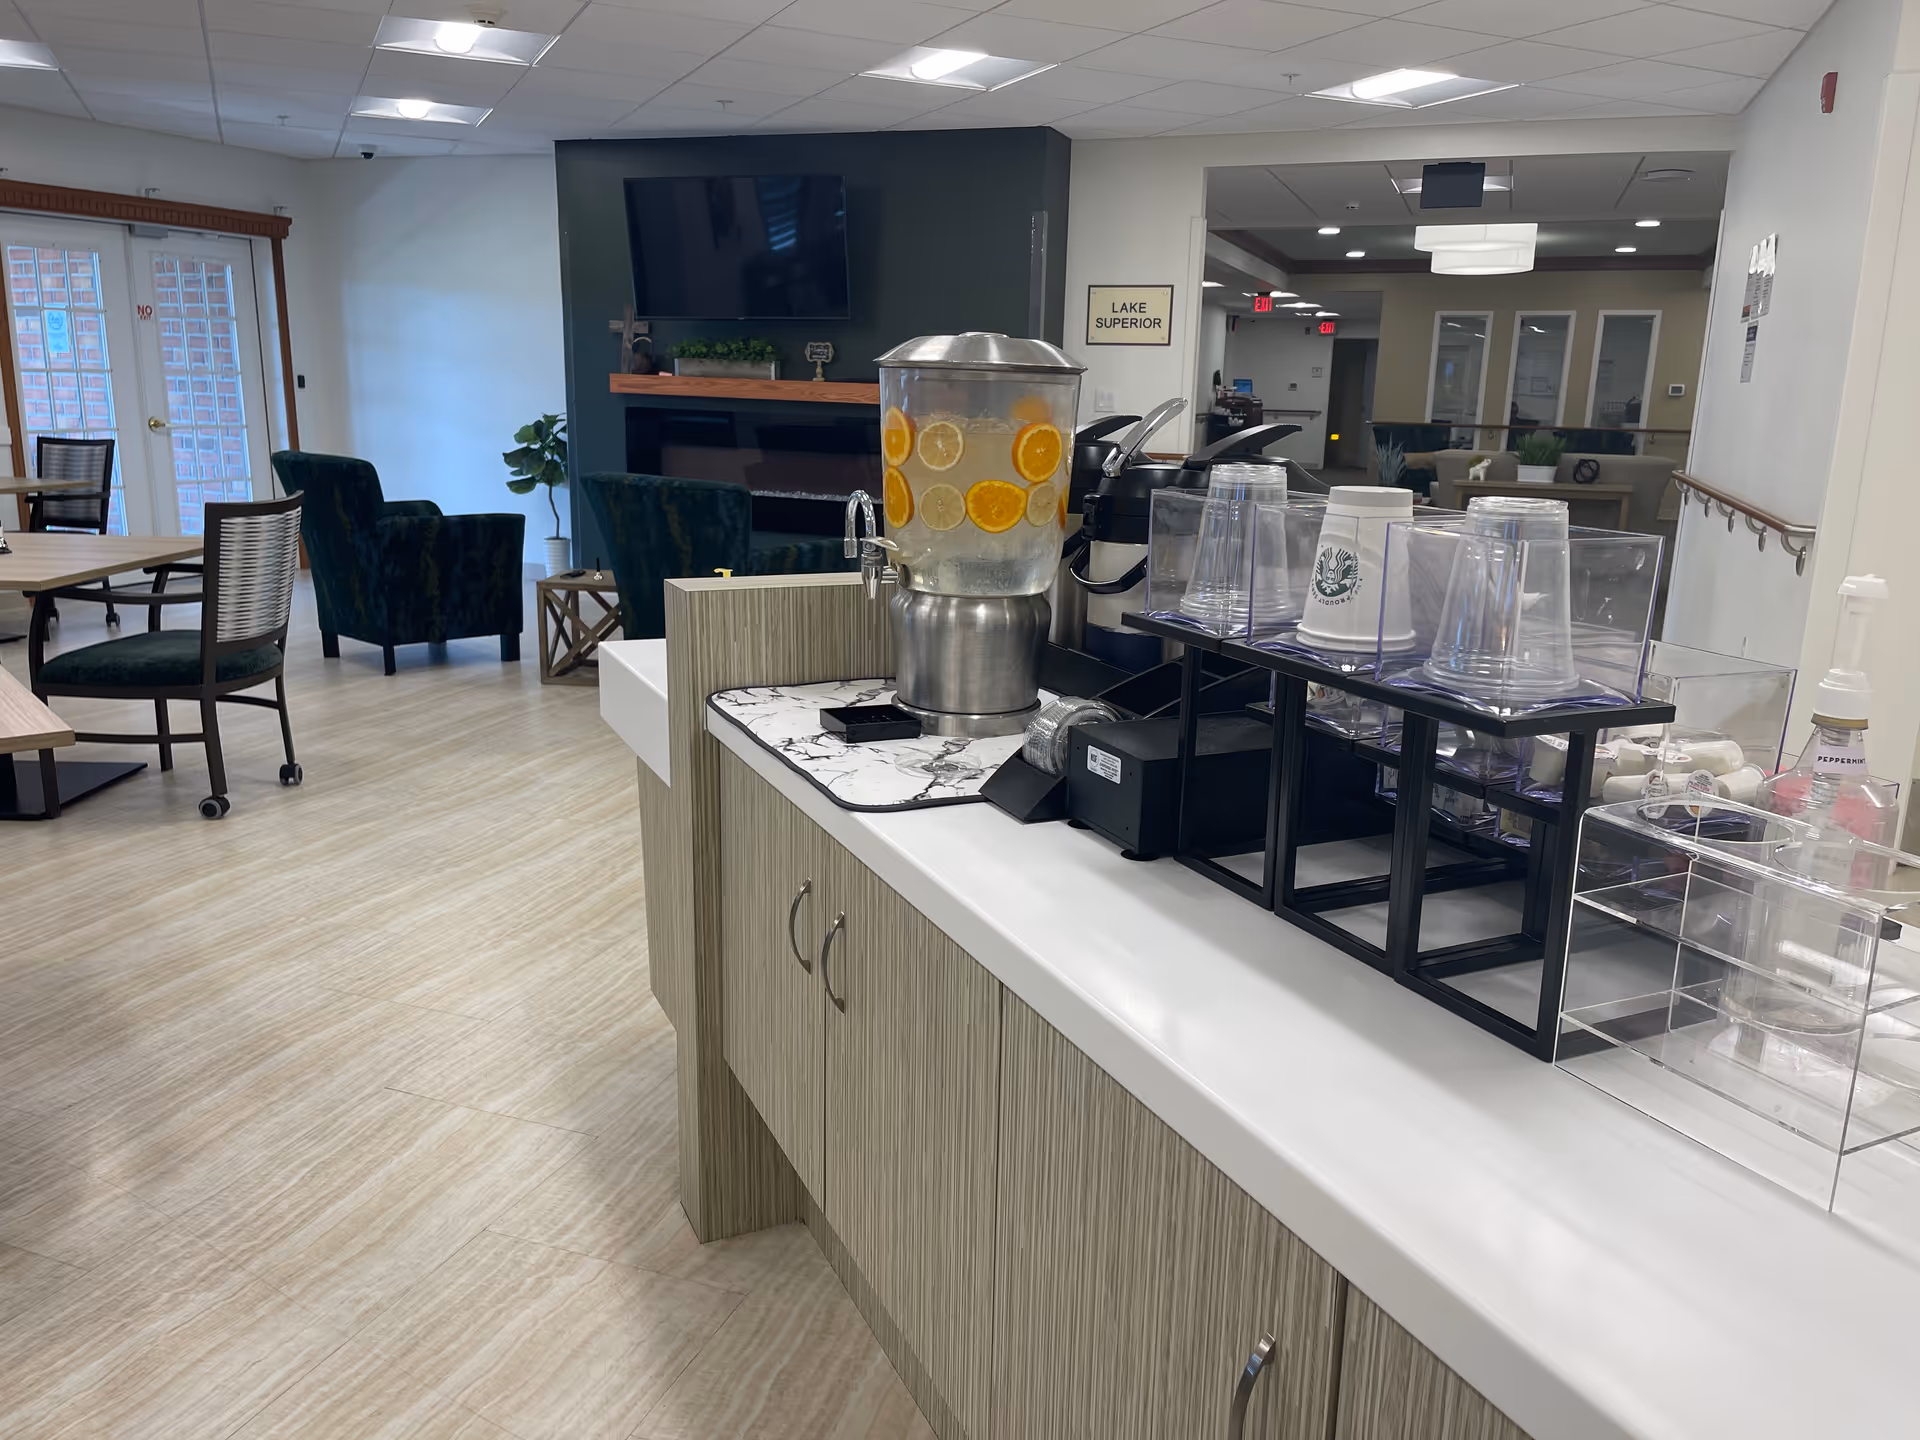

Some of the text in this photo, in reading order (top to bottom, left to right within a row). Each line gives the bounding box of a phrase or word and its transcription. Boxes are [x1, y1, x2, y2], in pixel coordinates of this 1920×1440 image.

[137, 304, 153, 315] NO
[1112, 302, 1147, 314] LAKE
[1254, 297, 1273, 312] EXIT
[1095, 317, 1162, 329] SUPERIOR
[1320, 321, 1336, 334] EXIT
[1318, 595, 1351, 606] PROUDLY
